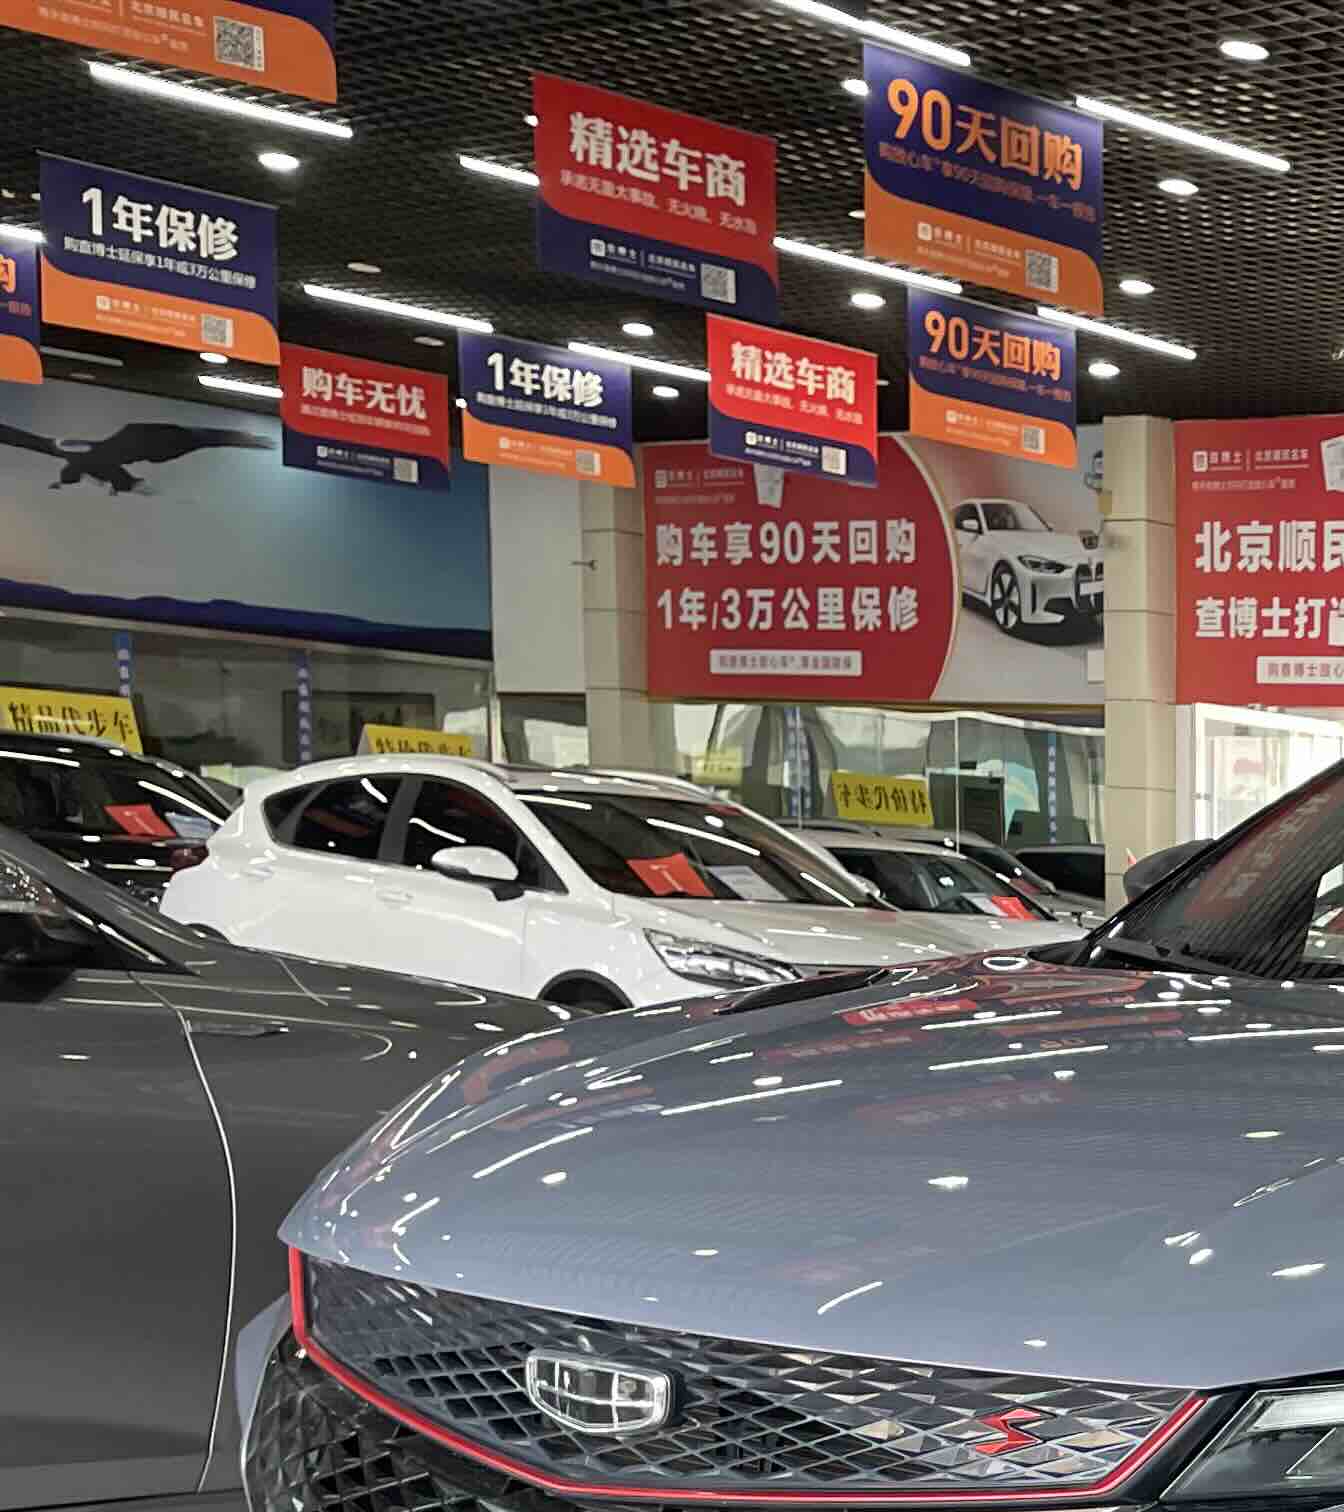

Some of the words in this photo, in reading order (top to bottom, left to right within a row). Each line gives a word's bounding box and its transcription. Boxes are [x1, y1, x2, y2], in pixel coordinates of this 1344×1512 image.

[570, 112, 745, 206] 精选车商
[887, 79, 1082, 191] 90天回购
[82, 187, 239, 261] 1年保修
[731, 341, 855, 405] 精选车商
[924, 310, 1061, 381] 90天回购
[301, 366, 428, 421] 购车无忧
[487, 353, 603, 407] 1年保修
[655, 519, 917, 567] 购车享90天回购
[656, 587, 919, 632] 1年/3万公里保修
